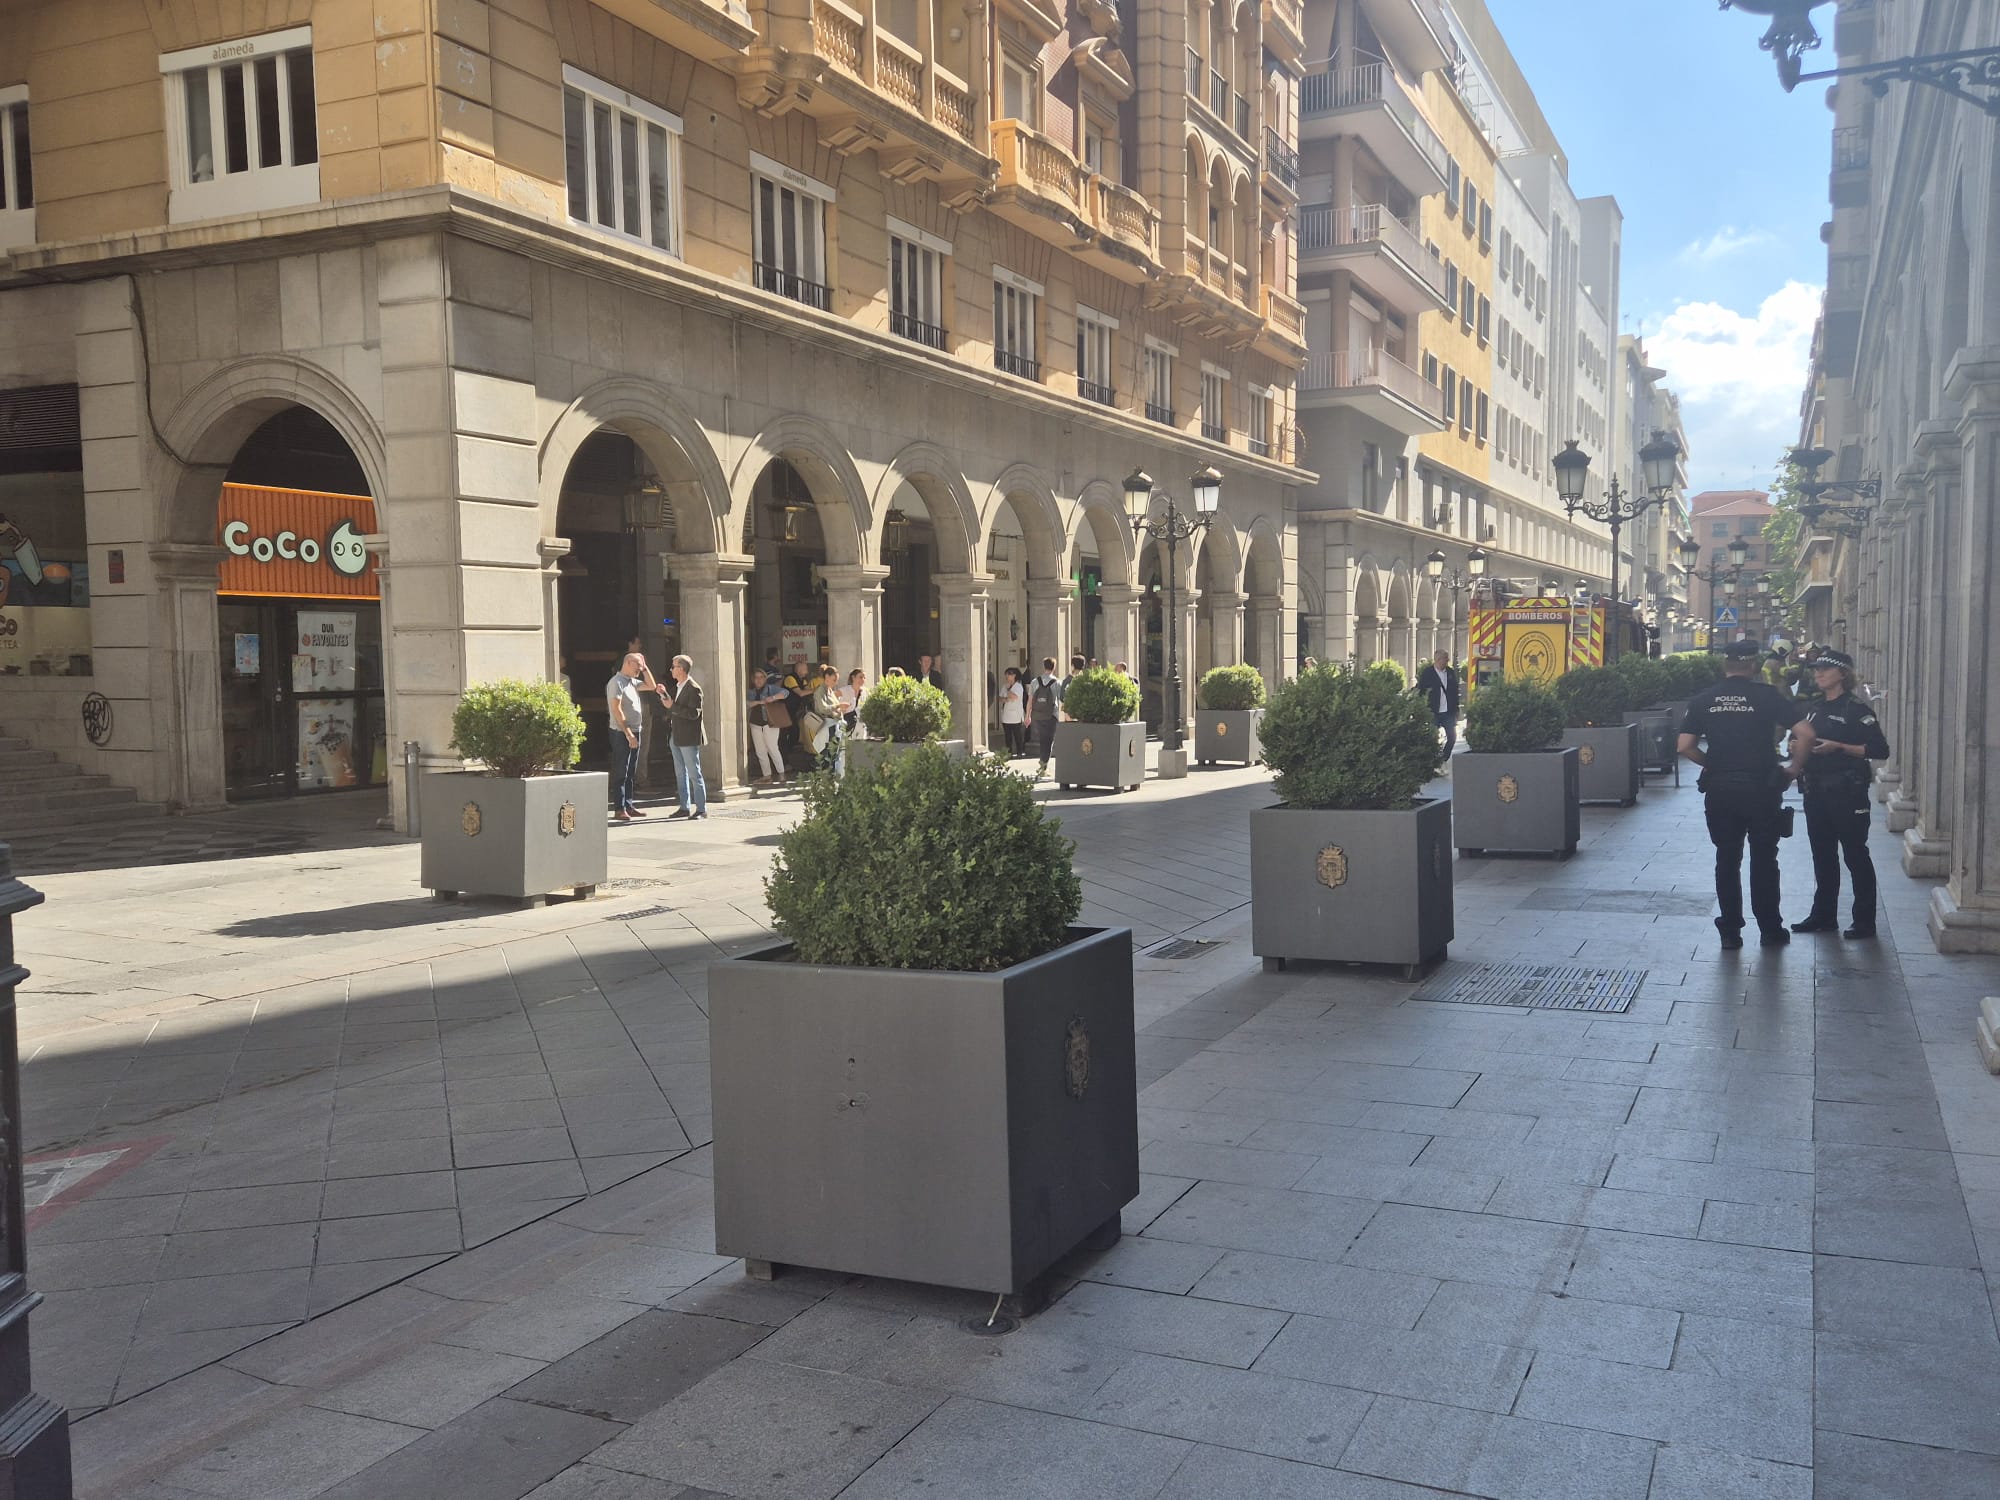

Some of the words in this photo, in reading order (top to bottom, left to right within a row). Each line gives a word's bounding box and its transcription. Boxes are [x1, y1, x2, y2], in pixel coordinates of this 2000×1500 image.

[212, 41, 255, 60] alameda
[223, 520, 320, 563] CoCo
[1508, 612, 1563, 620] BOMBEROS
[321, 623, 335, 633] OUR
